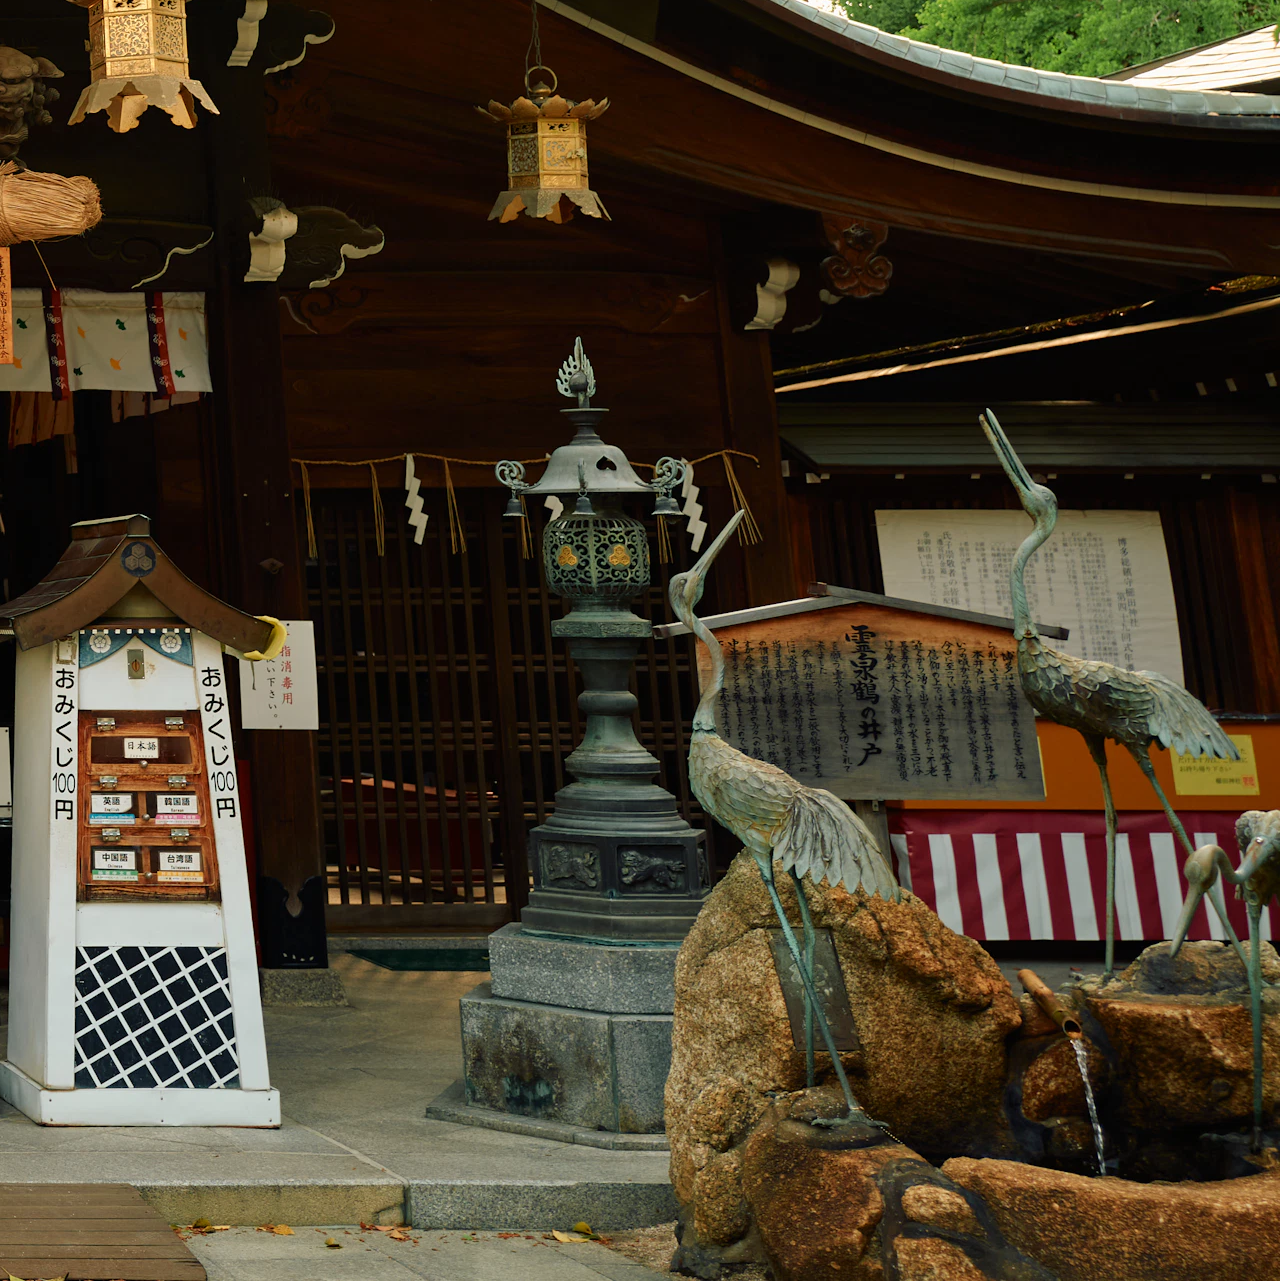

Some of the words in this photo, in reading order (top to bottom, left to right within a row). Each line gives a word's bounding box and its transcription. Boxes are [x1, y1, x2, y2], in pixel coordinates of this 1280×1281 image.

[280, 633, 293, 705] 指消毒用
[816, 640, 827, 675] 来ました
[941, 640, 958, 707] 今日に至っています
[988, 641, 999, 691] られています
[845, 625, 882, 767] 霊泉鶴の井戸
[51, 667, 77, 822] おみくじ100円
[127, 741, 157, 751] 日本語
[200, 665, 237, 820] おみくじ100円
[103, 796, 121, 806] 英語
[164, 797, 190, 806] 韓国語
[102, 853, 128, 862] 中国語
[167, 854, 193, 863] 台湾語
